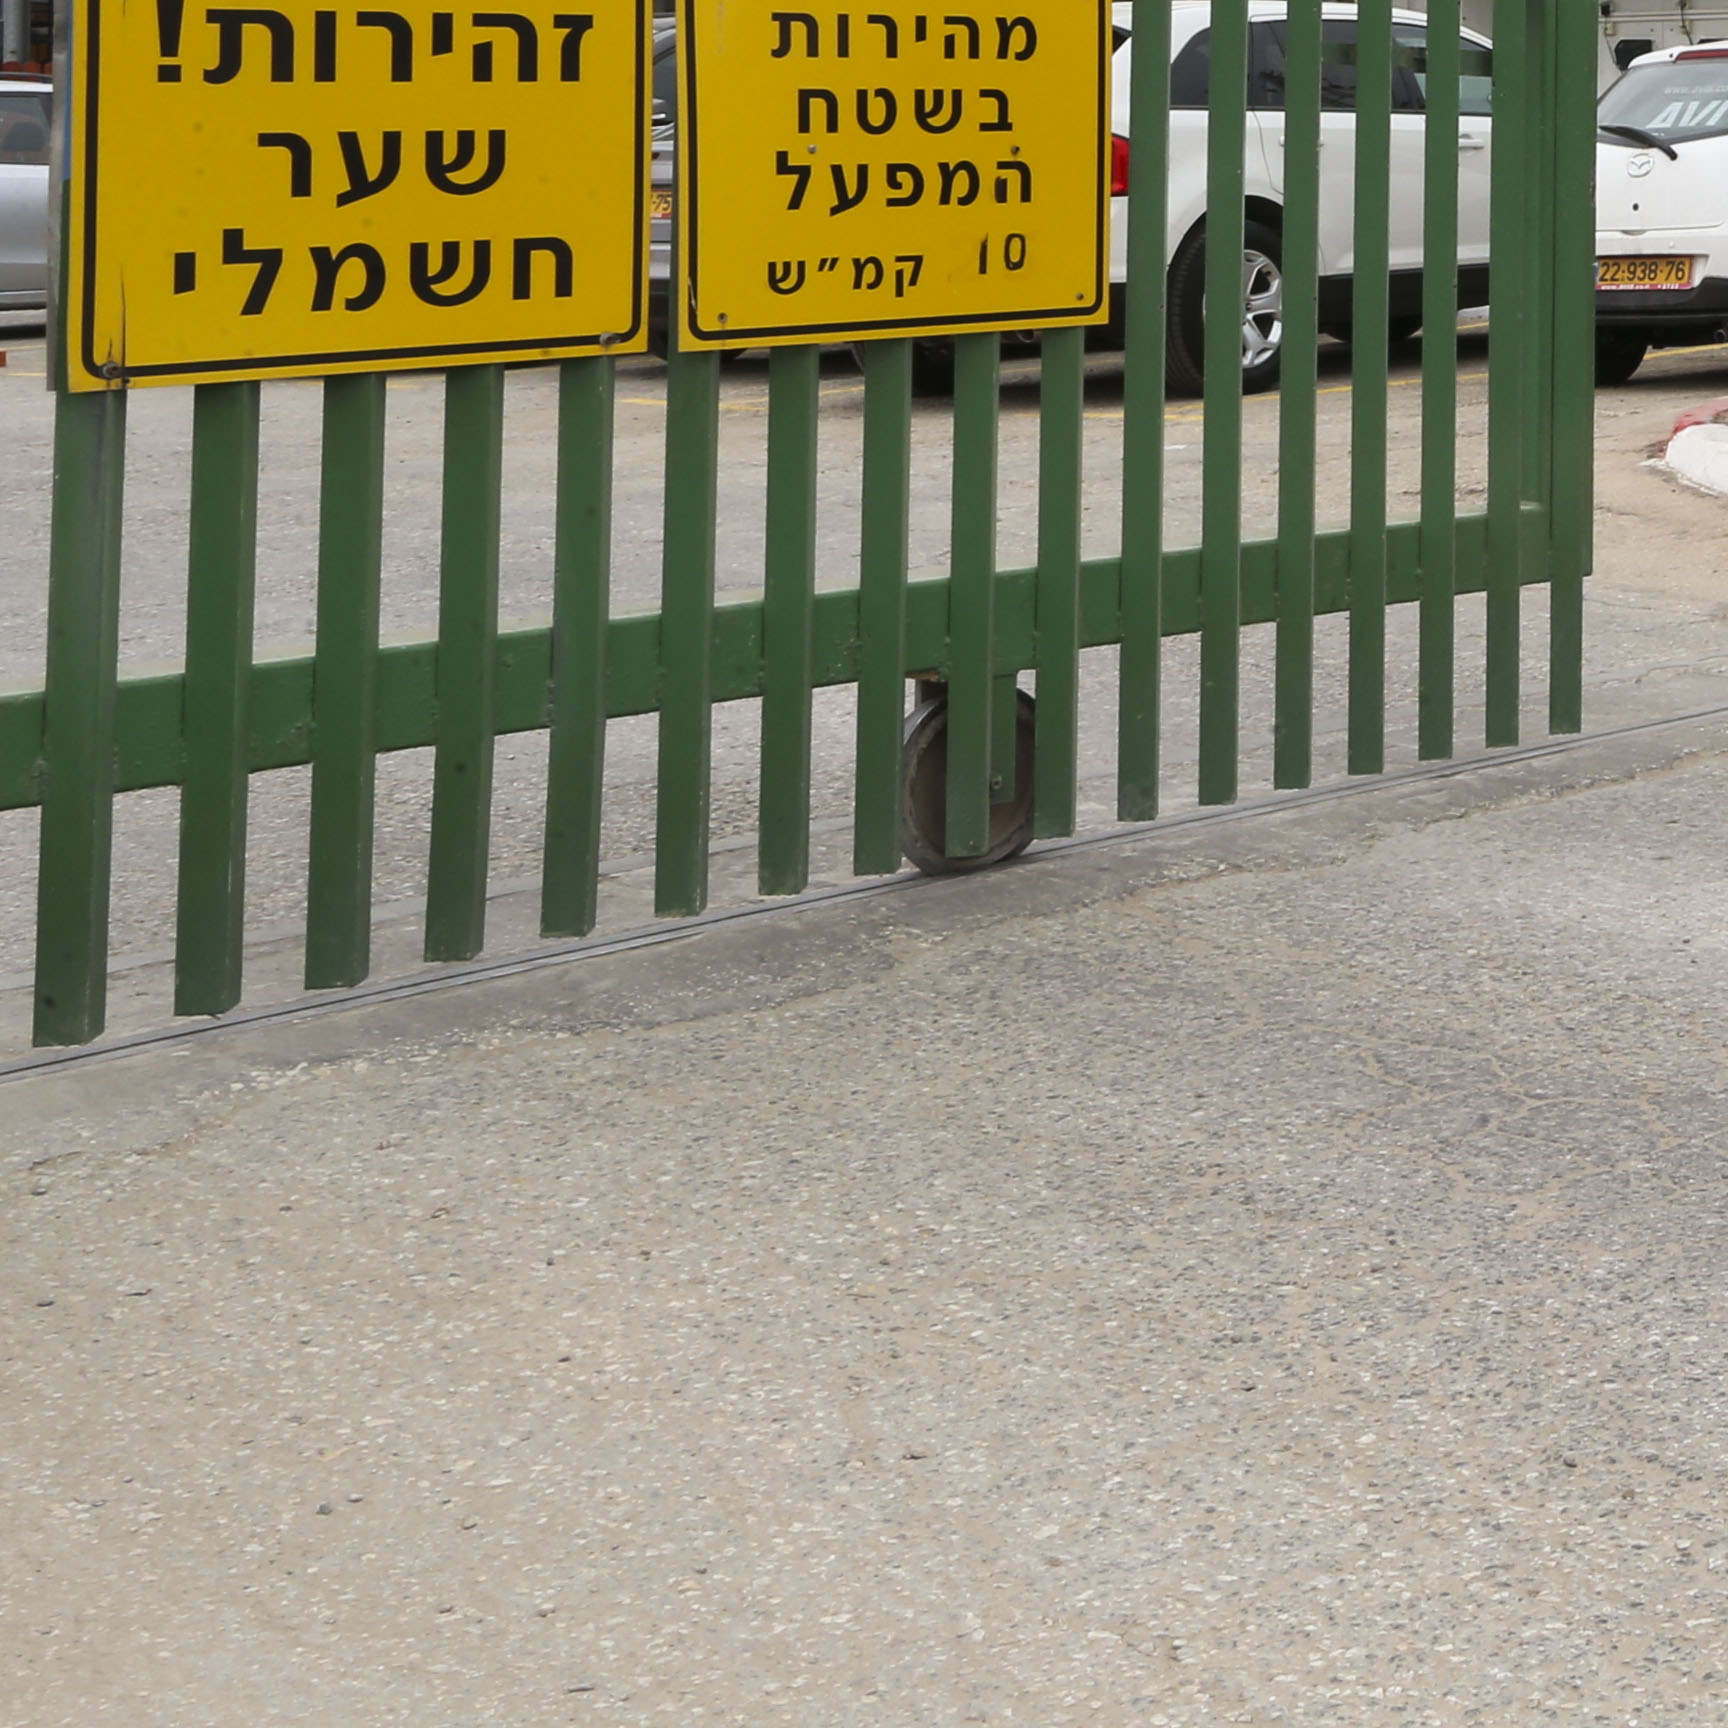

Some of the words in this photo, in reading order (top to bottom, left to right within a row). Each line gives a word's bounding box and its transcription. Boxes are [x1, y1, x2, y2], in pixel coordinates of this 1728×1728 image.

[771, 11, 1038, 62] מהירות
[798, 87, 1014, 135] בשטח
[258, 129, 507, 207] שער
[776, 150, 1033, 217] המפעל
[173, 228, 573, 316] חשמלי
